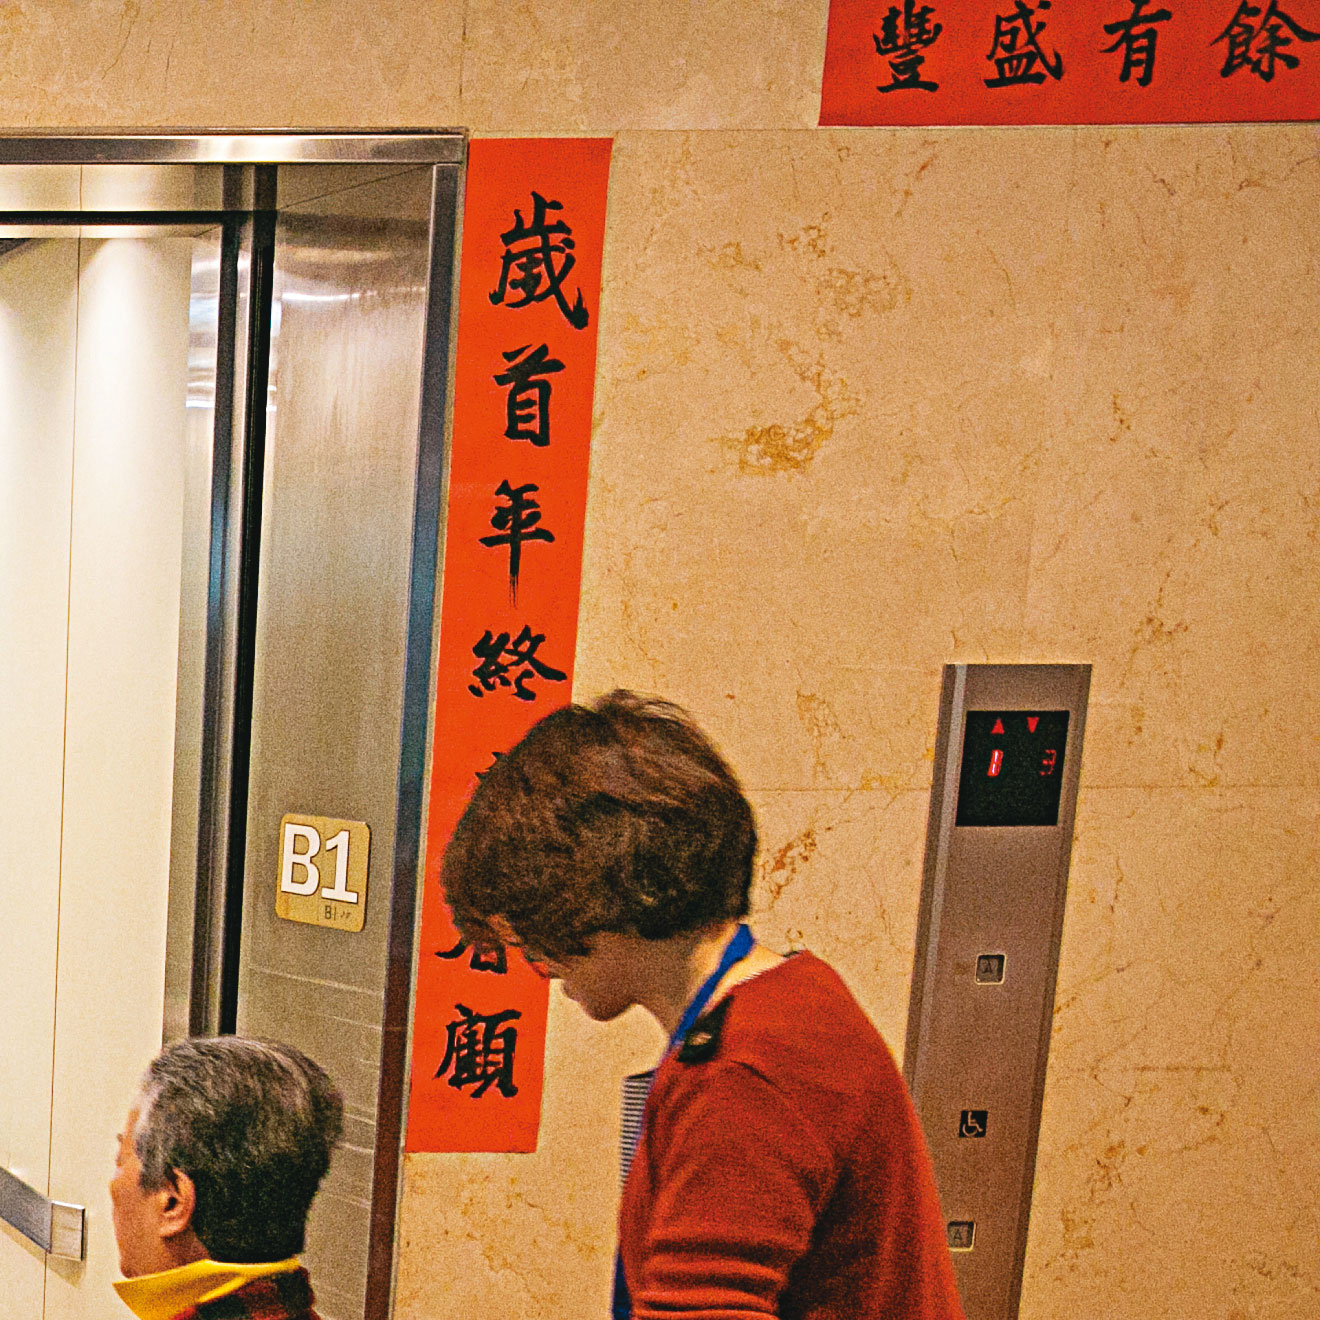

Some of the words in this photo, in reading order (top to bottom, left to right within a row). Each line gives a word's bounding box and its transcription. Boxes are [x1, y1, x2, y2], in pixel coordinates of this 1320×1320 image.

[872, 0, 1320, 93] 豐盛有餘
[436, 190, 590, 1099] 歲首年終顧
[280, 822, 359, 904] B1
